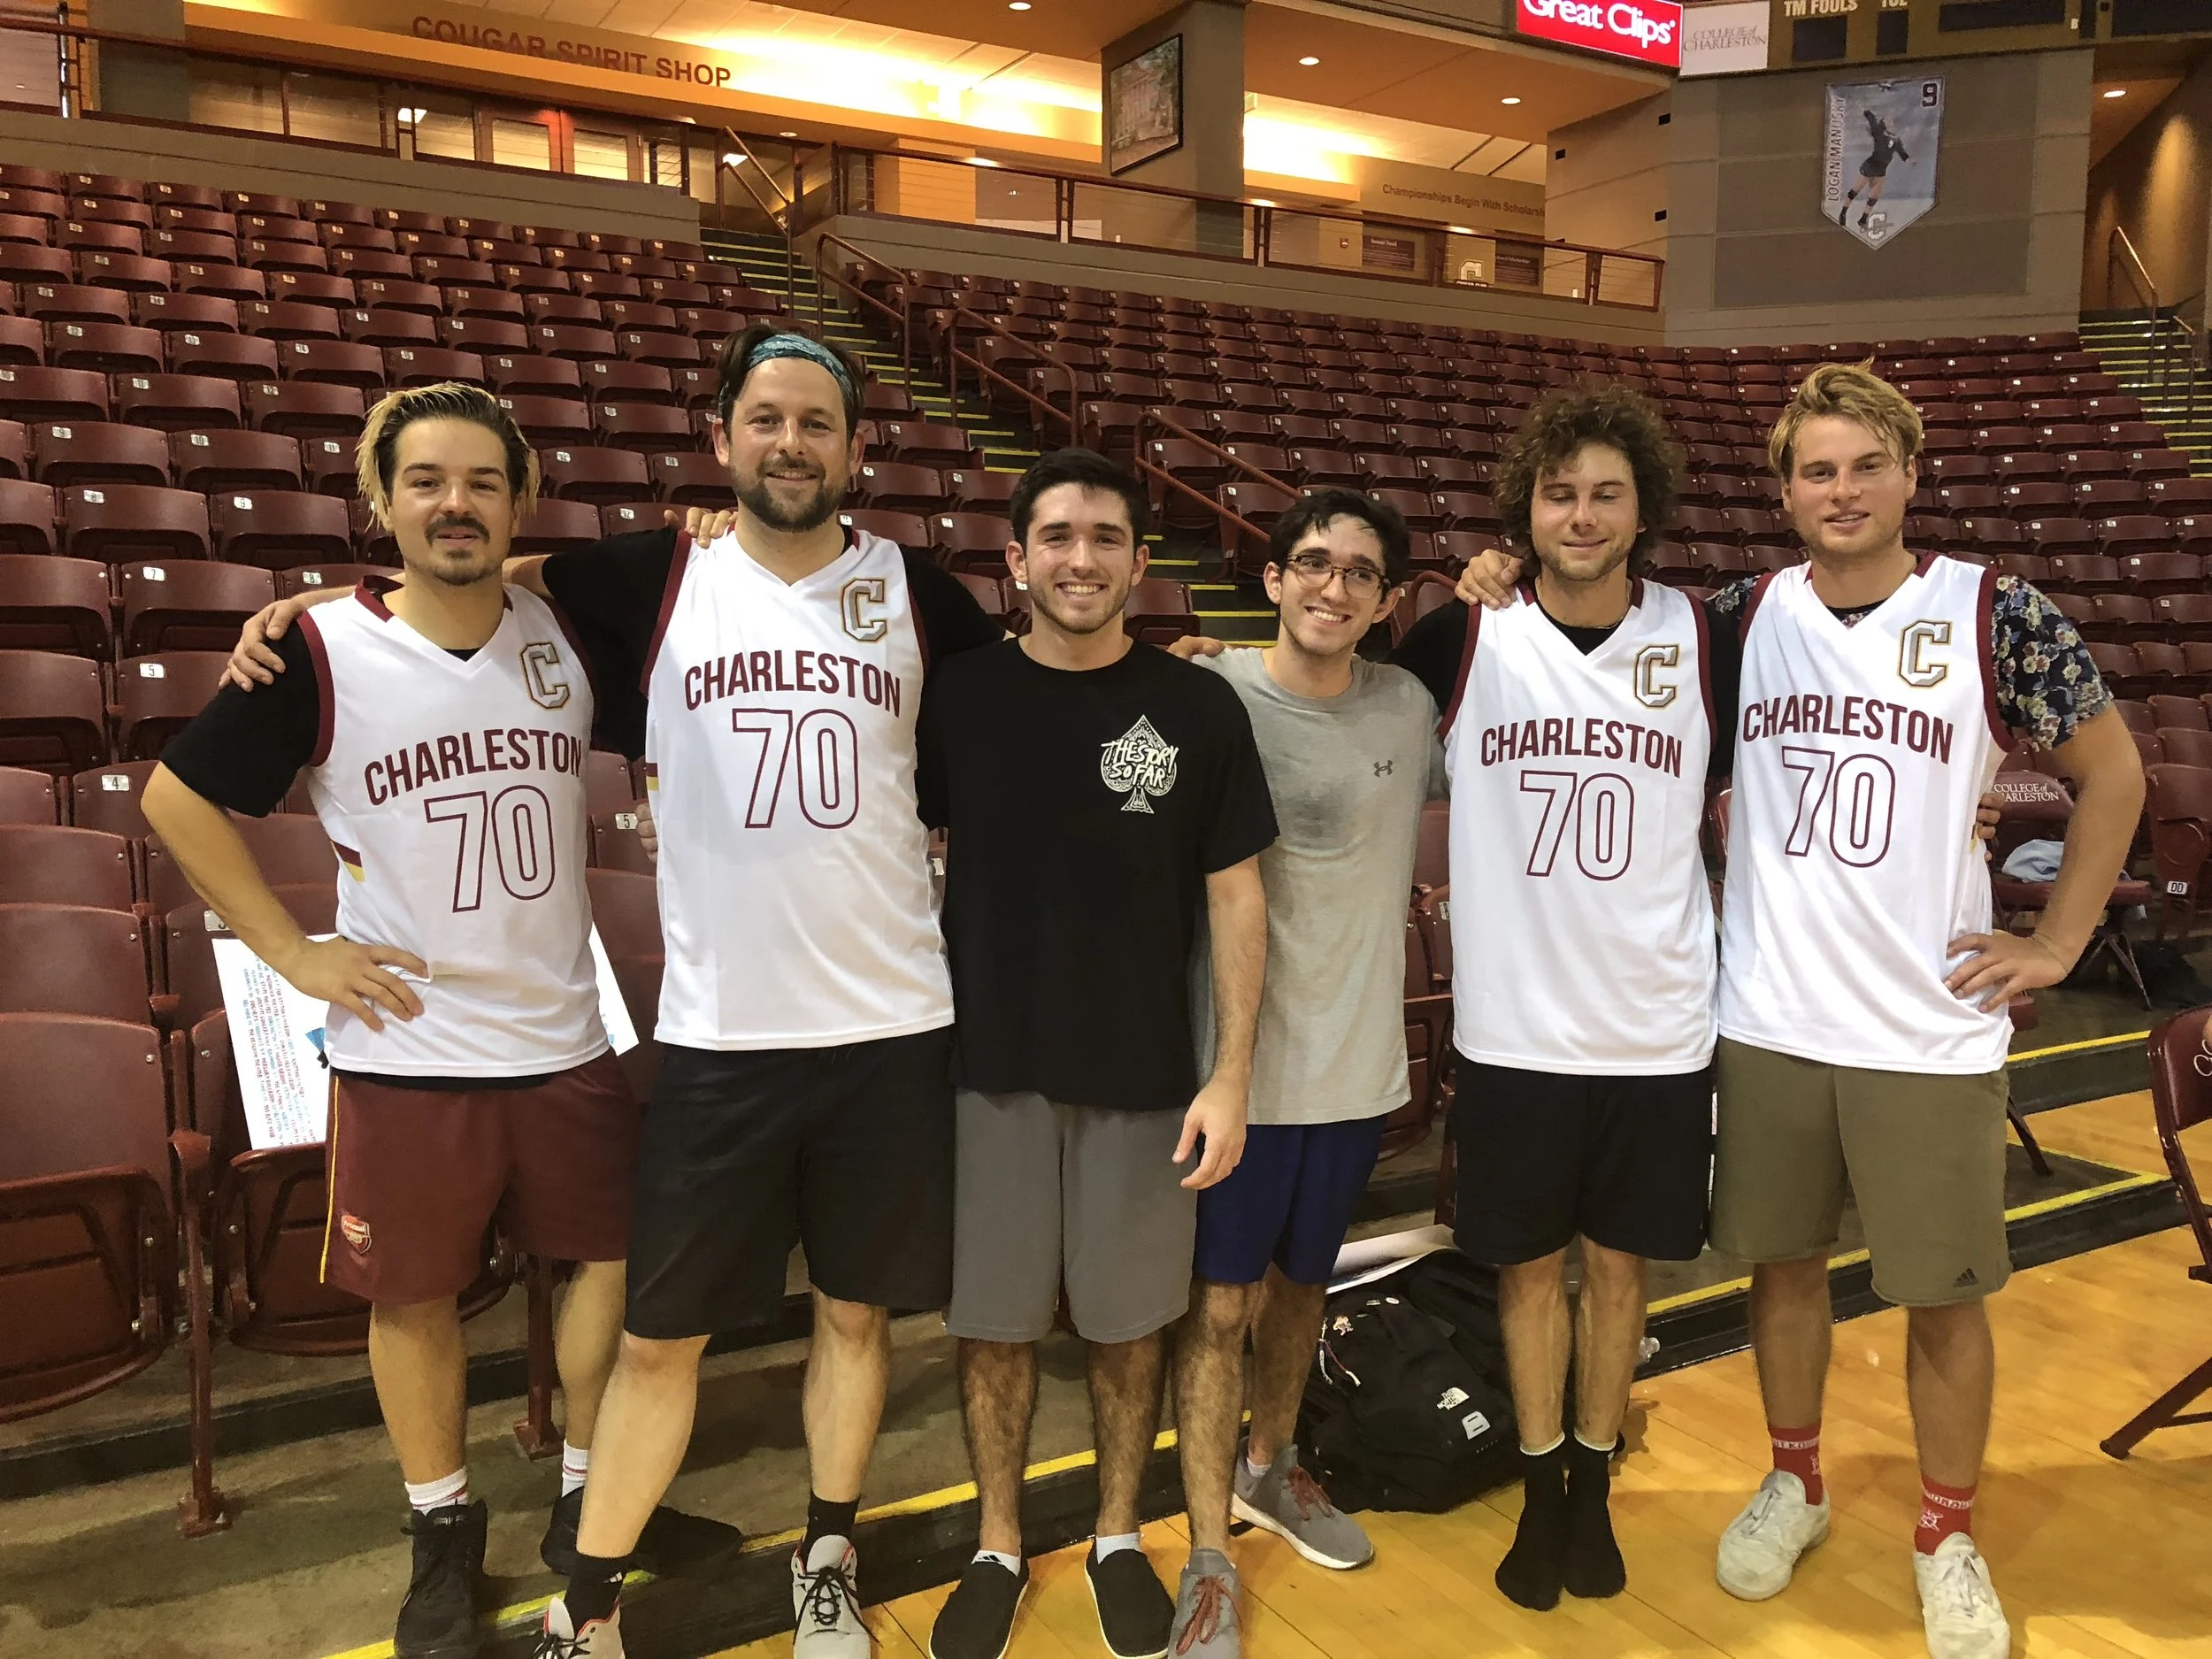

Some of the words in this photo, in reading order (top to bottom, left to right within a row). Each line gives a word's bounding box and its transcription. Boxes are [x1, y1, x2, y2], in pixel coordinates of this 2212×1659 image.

[1526, 0, 1603, 30] Great
[1784, 1, 1806, 17] TM
[1811, 0, 1858, 15] FOULS
[411, 16, 547, 57] COUGAR
[556, 41, 648, 73] SPIRIT
[655, 58, 731, 87] SHOP
[1684, 35, 1766, 51] CHARLESTON
[1694, 26, 1747, 39] COLLEGE
[1922, 82, 1938, 107] 9
[1382, 183, 1452, 204] Championships
[1455, 195, 1479, 209] Begin
[1482, 198, 1502, 211] With
[1827, 161, 1840, 202] LOGAN
[194, 435, 203, 444] 10
[841, 577, 889, 643] C
[1897, 618, 1954, 688] C
[519, 641, 571, 710] C
[684, 649, 901, 718] CHARLESTON
[1633, 642, 1681, 710] C
[1480, 717, 1683, 779] CHARLESTON
[1743, 694, 1954, 765] CHARLESTON
[364, 727, 583, 806] CHARLESTON
[733, 708, 859, 830] 70
[1101, 739, 1138, 764] THE
[1137, 744, 1179, 774] STORY
[1110, 762, 1133, 779] SO
[1132, 763, 1166, 788] FAR
[111, 776, 119, 789] 4
[1993, 783, 2039, 794] COLLEGE
[2039, 783, 2047, 796] of
[2001, 791, 2060, 803] ARLESTON
[622, 814, 629, 829] 5
[1519, 770, 1634, 881] 70
[1781, 745, 1895, 868] 70
[424, 784, 556, 914] 70
[2170, 882, 2184, 893] DD
